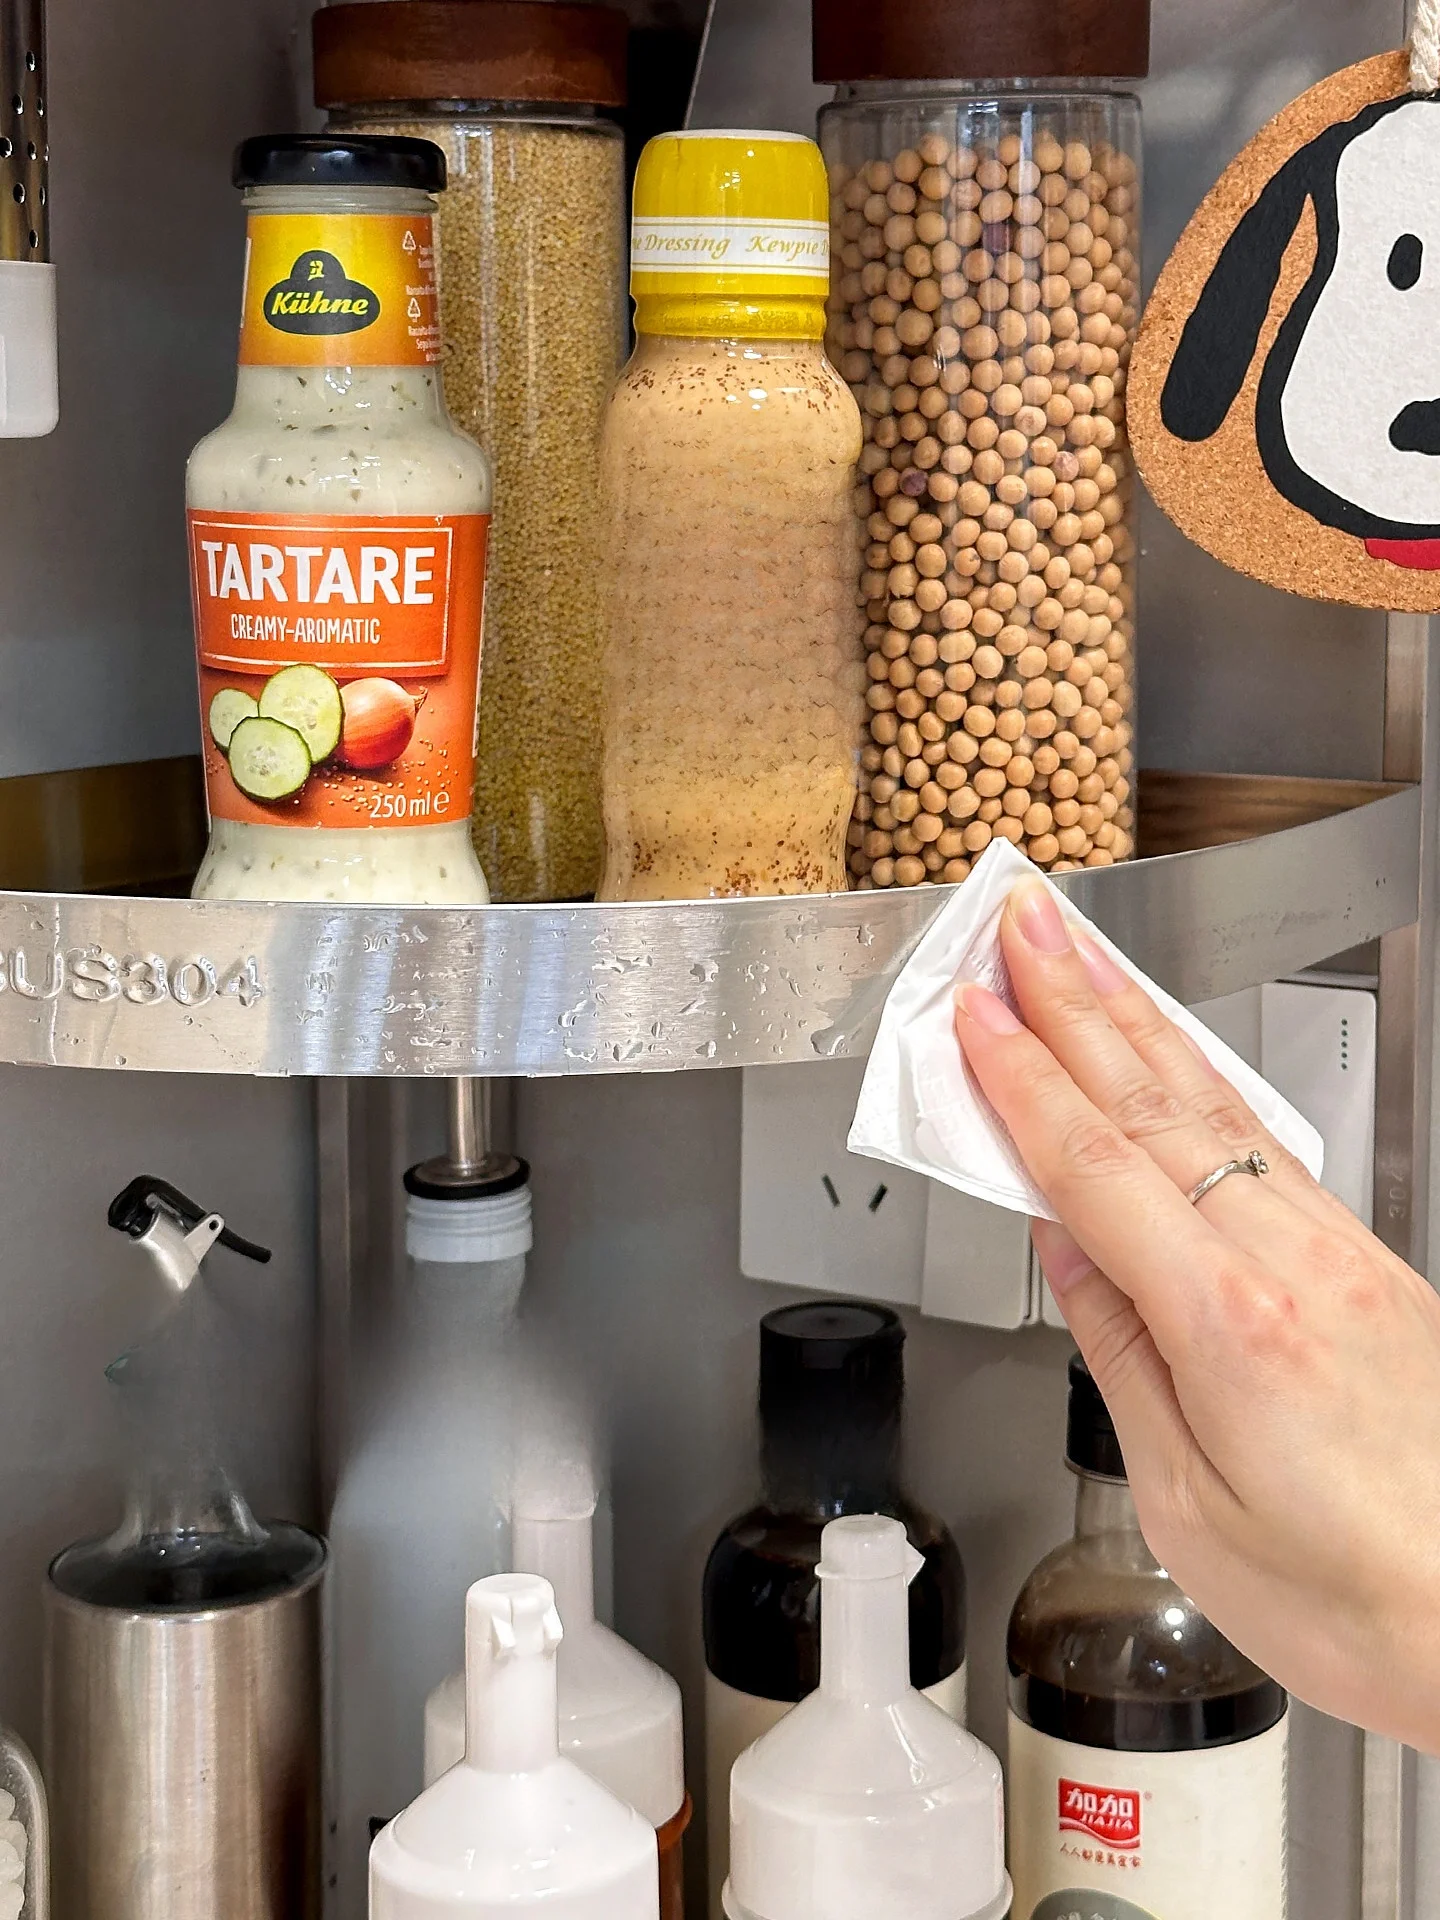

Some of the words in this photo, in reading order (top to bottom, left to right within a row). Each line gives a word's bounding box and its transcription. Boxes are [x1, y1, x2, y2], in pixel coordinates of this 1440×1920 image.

[644, 233, 731, 260] Dressing
[745, 234, 818, 262] Kewpie
[271, 291, 369, 316] Kühne
[201, 541, 435, 605] TARTARE
[230, 613, 381, 644] CREAMY-AROMATIC
[370, 794, 407, 819] 250
[0, 946, 265, 1008] US304
[1066, 1787, 1133, 1818] 加加
